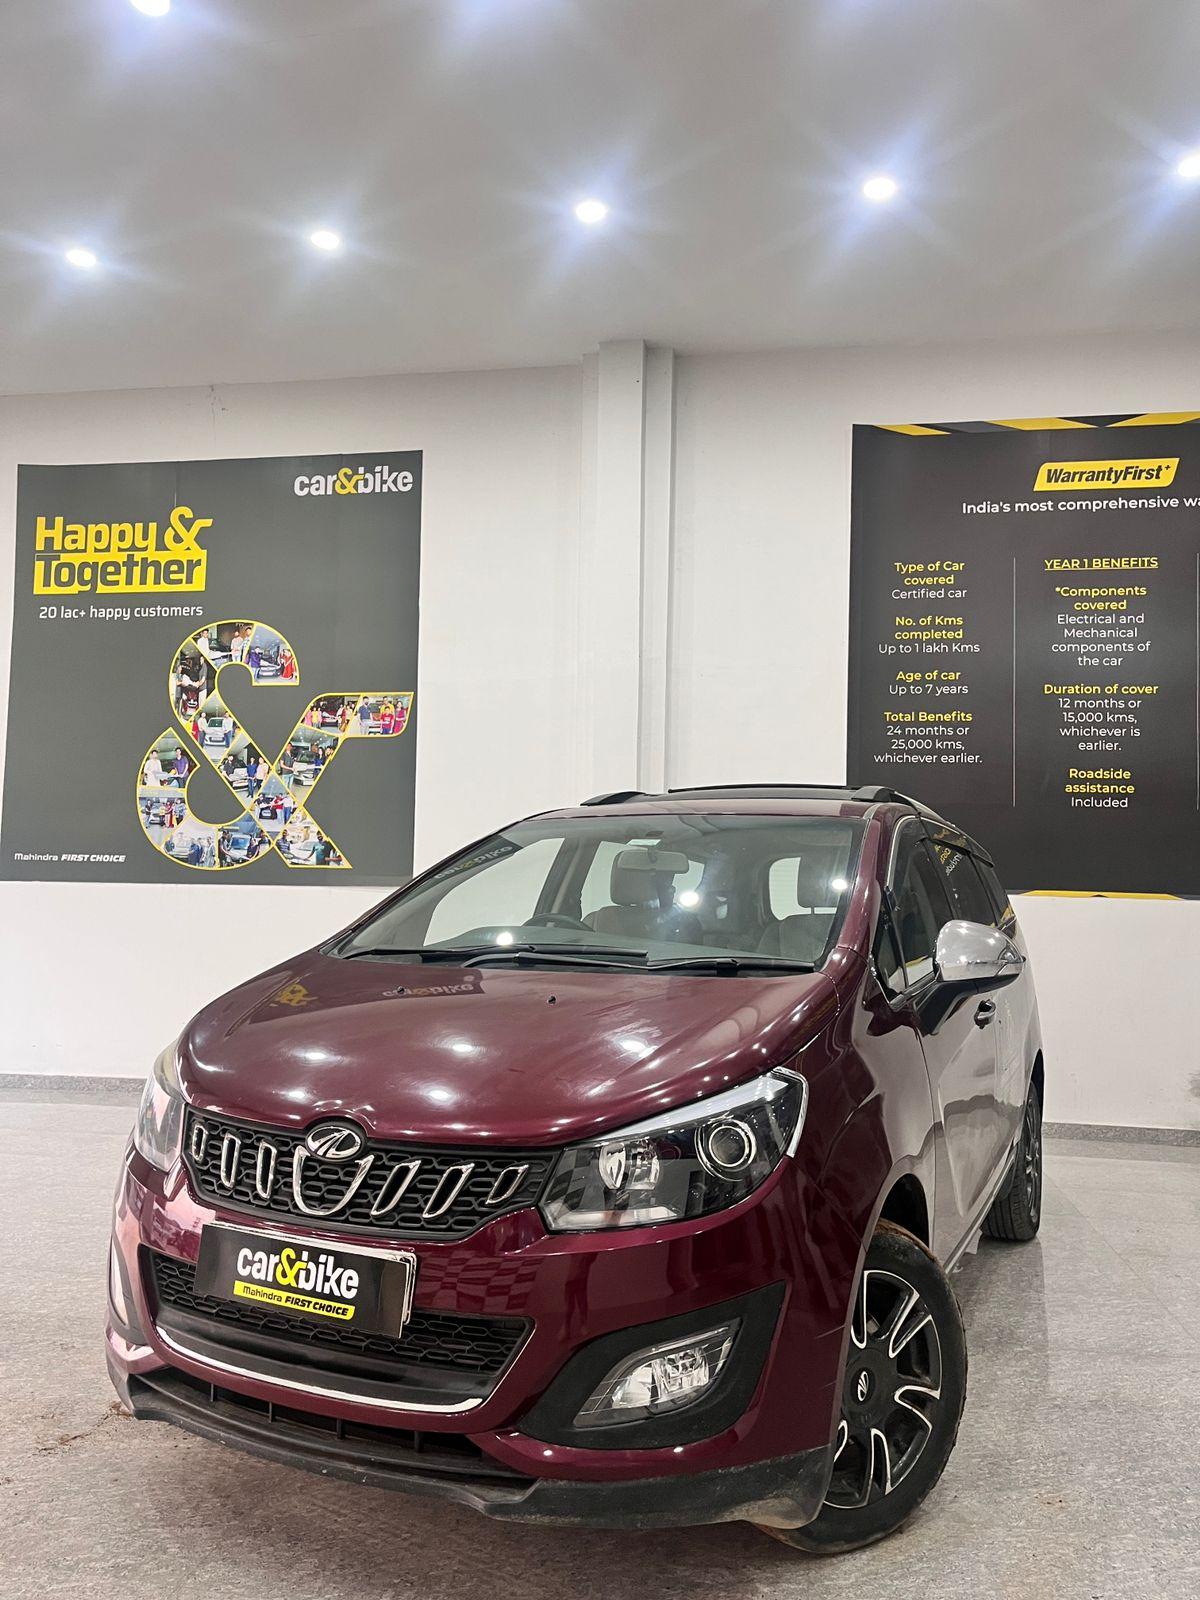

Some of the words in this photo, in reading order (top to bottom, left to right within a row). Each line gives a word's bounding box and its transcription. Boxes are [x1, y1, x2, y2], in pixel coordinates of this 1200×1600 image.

[293, 465, 414, 497] car&bike
[963, 501, 1010, 513] India's
[1015, 501, 1053, 512] most
[1058, 496, 1179, 512] comprehensive
[35, 516, 157, 553] Happy
[164, 506, 213, 552] &
[894, 562, 922, 575] Type
[923, 561, 941, 571] of
[943, 561, 964, 570] Car
[1044, 558, 1081, 570] YEAR
[1083, 559, 1089, 569] 1
[1092, 557, 1159, 569] BENEFITS
[35, 554, 202, 594] Together
[903, 575, 955, 586] covered
[892, 588, 944, 599] Certified
[948, 590, 967, 598] car
[1074, 600, 1126, 610] covered
[39, 607, 57, 618] 20
[61, 606, 86, 618] lac+
[90, 605, 130, 620] happy
[134, 605, 205, 617] customers
[896, 617, 916, 626] No.
[919, 616, 932, 625] of
[936, 616, 963, 625] Kms
[1058, 614, 1115, 624] Electrical
[1119, 613, 1144, 623] and
[895, 629, 962, 641] completed
[1064, 627, 1138, 639] Mechanical
[879, 644, 896, 655] Up
[899, 645, 911, 653] to
[914, 643, 920, 653] 1
[923, 643, 948, 652] lakh
[953, 643, 980, 652] Kms
[1052, 643, 1134, 654] components
[1137, 641, 1151, 651] of
[1078, 655, 1099, 666] the
[1102, 657, 1123, 667] car
[896, 670, 922, 684] Age
[924, 670, 939, 681] of
[941, 672, 961, 680] car
[890, 685, 906, 696] Up
[910, 685, 922, 694] to
[925, 685, 933, 694] 7
[936, 686, 968, 696] years
[1045, 684, 1100, 694] Duration
[1105, 684, 1119, 694] of
[1122, 686, 1158, 694] cover
[1059, 698, 1070, 708] 12
[1075, 698, 1124, 708] months
[1127, 700, 1142, 709] or
[884, 712, 914, 721] Total
[919, 711, 972, 721] Benefits
[1063, 712, 1103, 723] 15,000
[1107, 712, 1137, 724] kms,
[887, 726, 902, 735] 24
[906, 725, 953, 735] months
[956, 726, 970, 736] or
[1060, 726, 1127, 736] whichever
[1131, 726, 1140, 736] is
[892, 739, 932, 750] 25,000
[936, 739, 964, 750] kms,
[1079, 740, 1121, 750] earlier.
[874, 753, 937, 762] whichever
[941, 753, 982, 763] earlier.
[1070, 768, 1131, 779] Roadside
[1065, 782, 1134, 793] assistance
[1072, 797, 1128, 807] Included
[14, 852, 59, 862] Mahindra
[60, 853, 90, 863] FIRST
[90, 854, 126, 863] CHOICE
[236, 1247, 360, 1299] car&bike
[242, 1285, 283, 1303] Mahindra
[284, 1295, 313, 1310] FIRST
[312, 1301, 349, 1317] CHOICE
